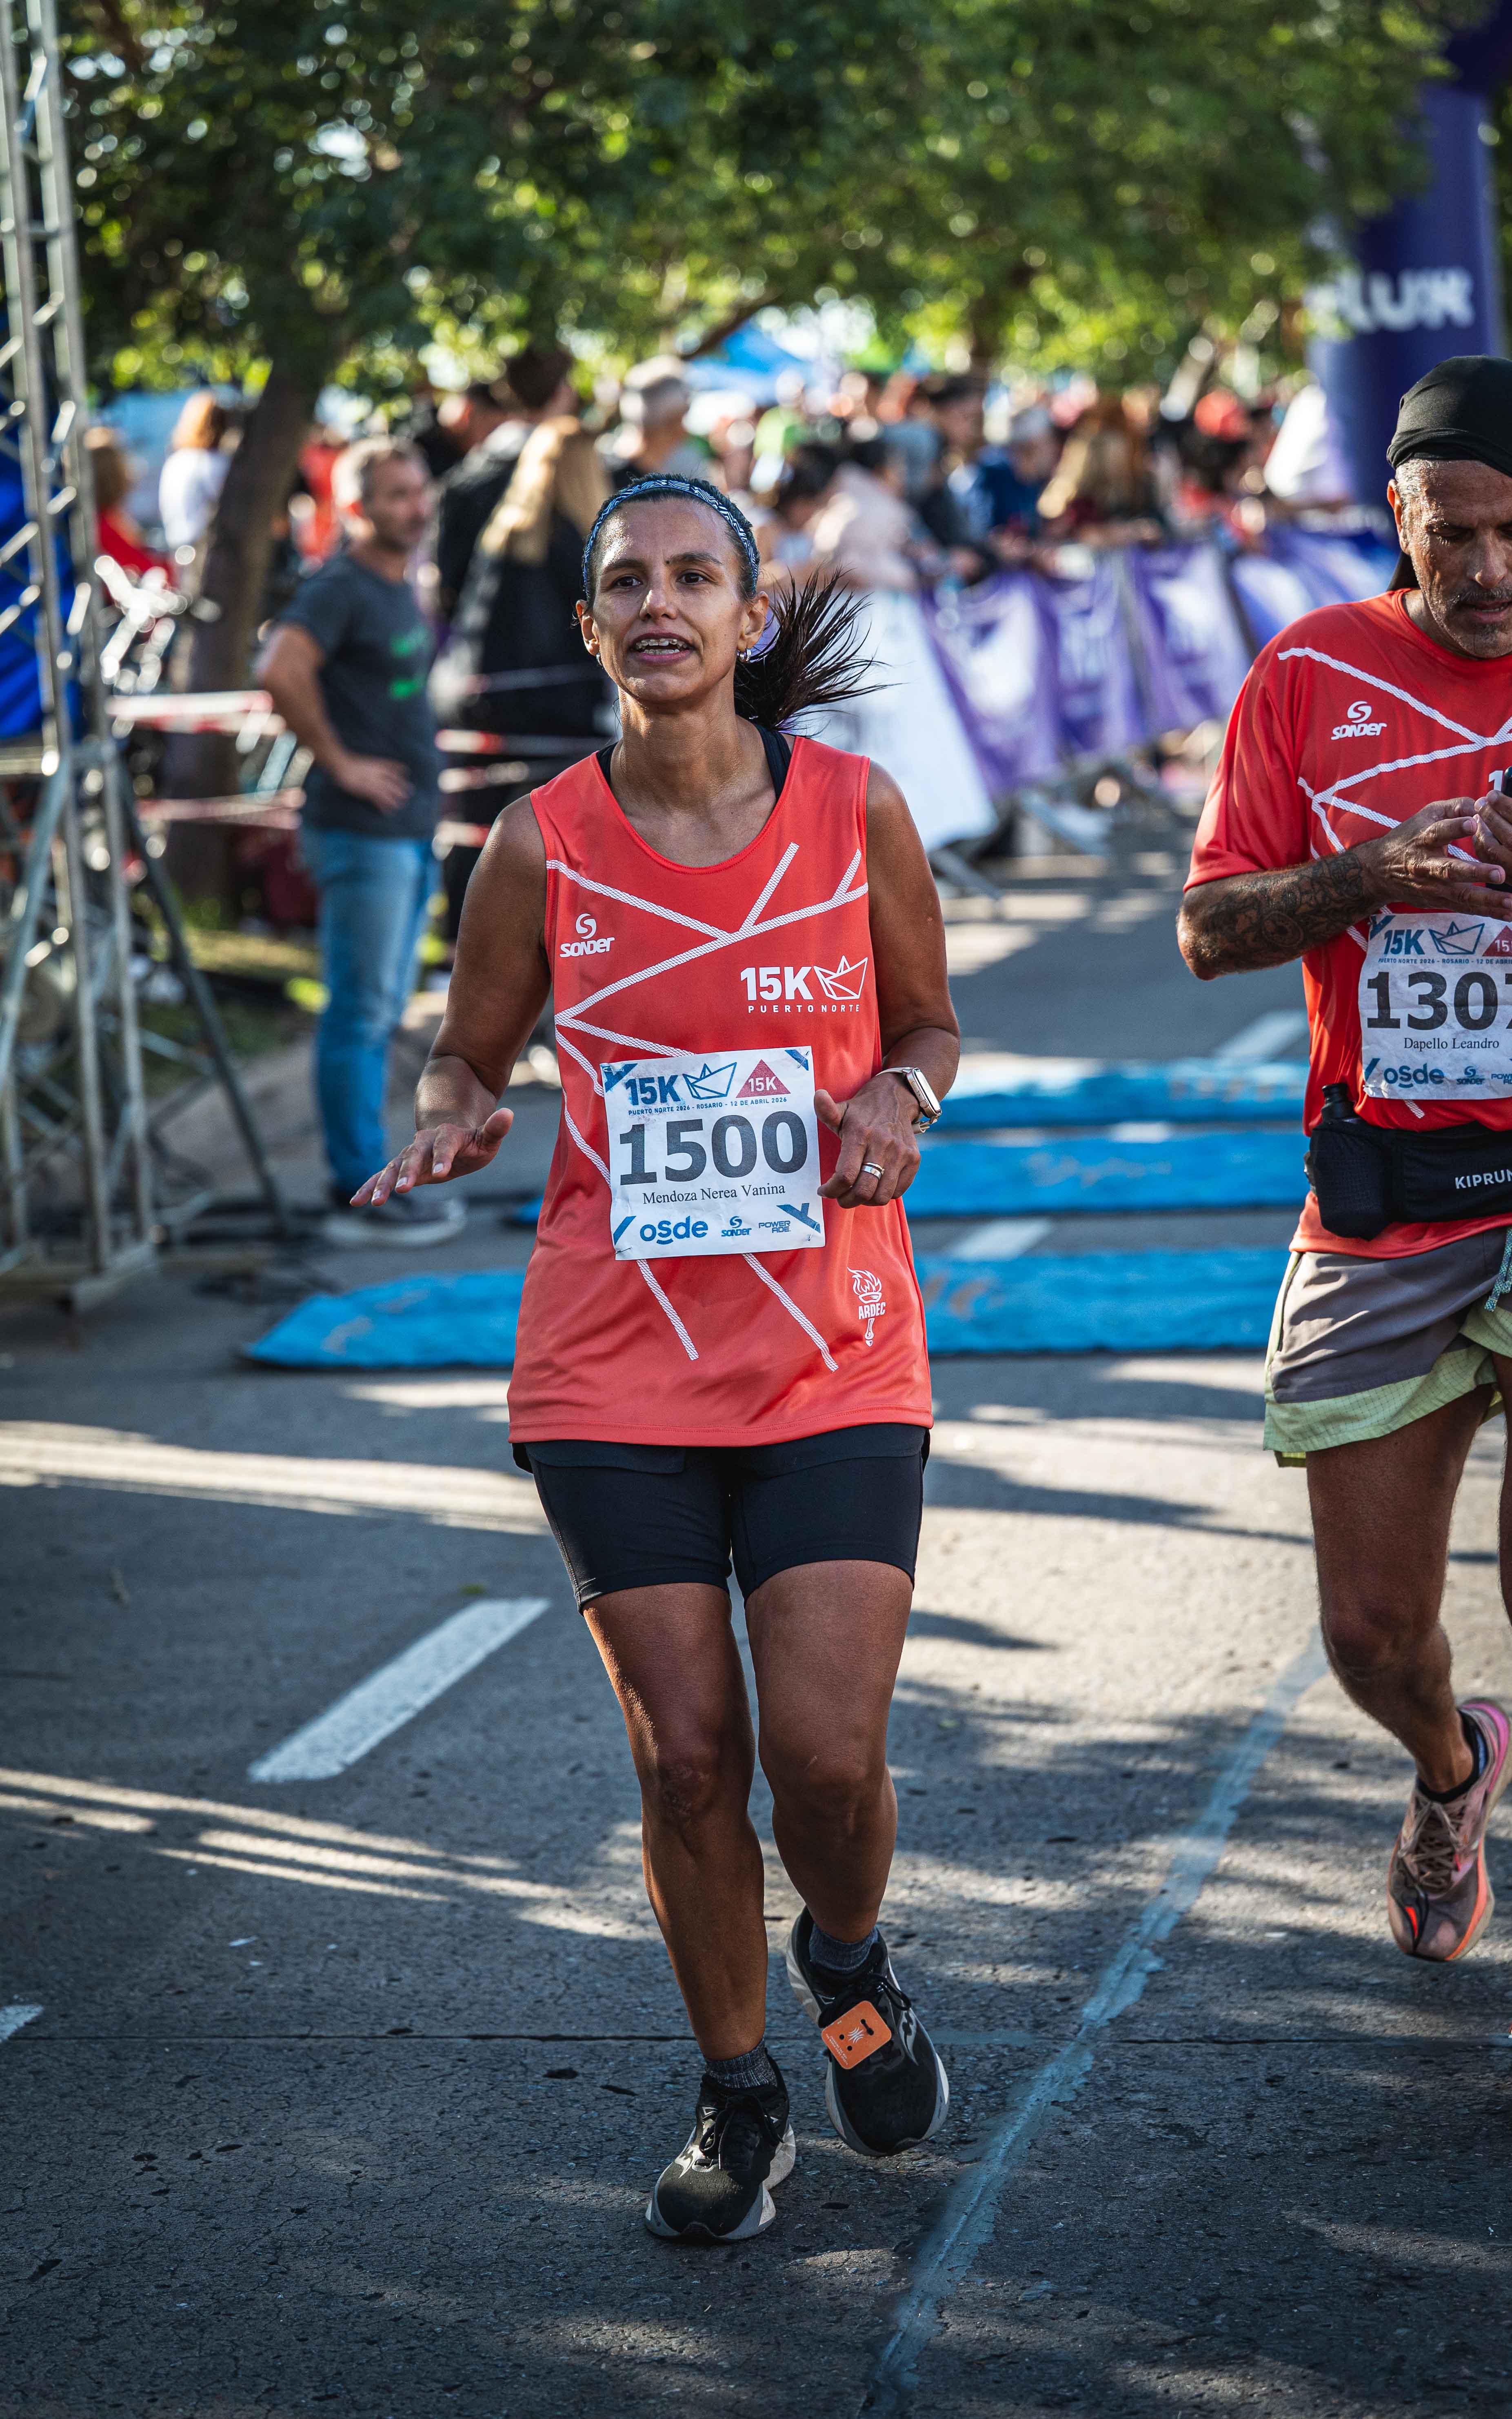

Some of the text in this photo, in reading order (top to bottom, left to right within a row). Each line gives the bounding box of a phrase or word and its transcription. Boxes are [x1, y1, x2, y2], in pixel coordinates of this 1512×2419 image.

[1383, 929, 1425, 955] 15K
[1495, 940, 1512, 953] 15
[741, 966, 814, 1001] 15K
[748, 1004, 859, 1014] PUERTO NORTE
[1367, 971, 1512, 1031] 130
[1404, 1037, 1499, 1052] Dapello Leandro
[748, 1076, 777, 1092] 15K
[1383, 1062, 1444, 1084] osde
[625, 1075, 681, 1106] 15K
[619, 1111, 808, 1185] 1500
[643, 1183, 786, 1204] Mendoza Nerea Vanina
[639, 1215, 708, 1242] osde
[858, 1302, 886, 1319] ARDEC
